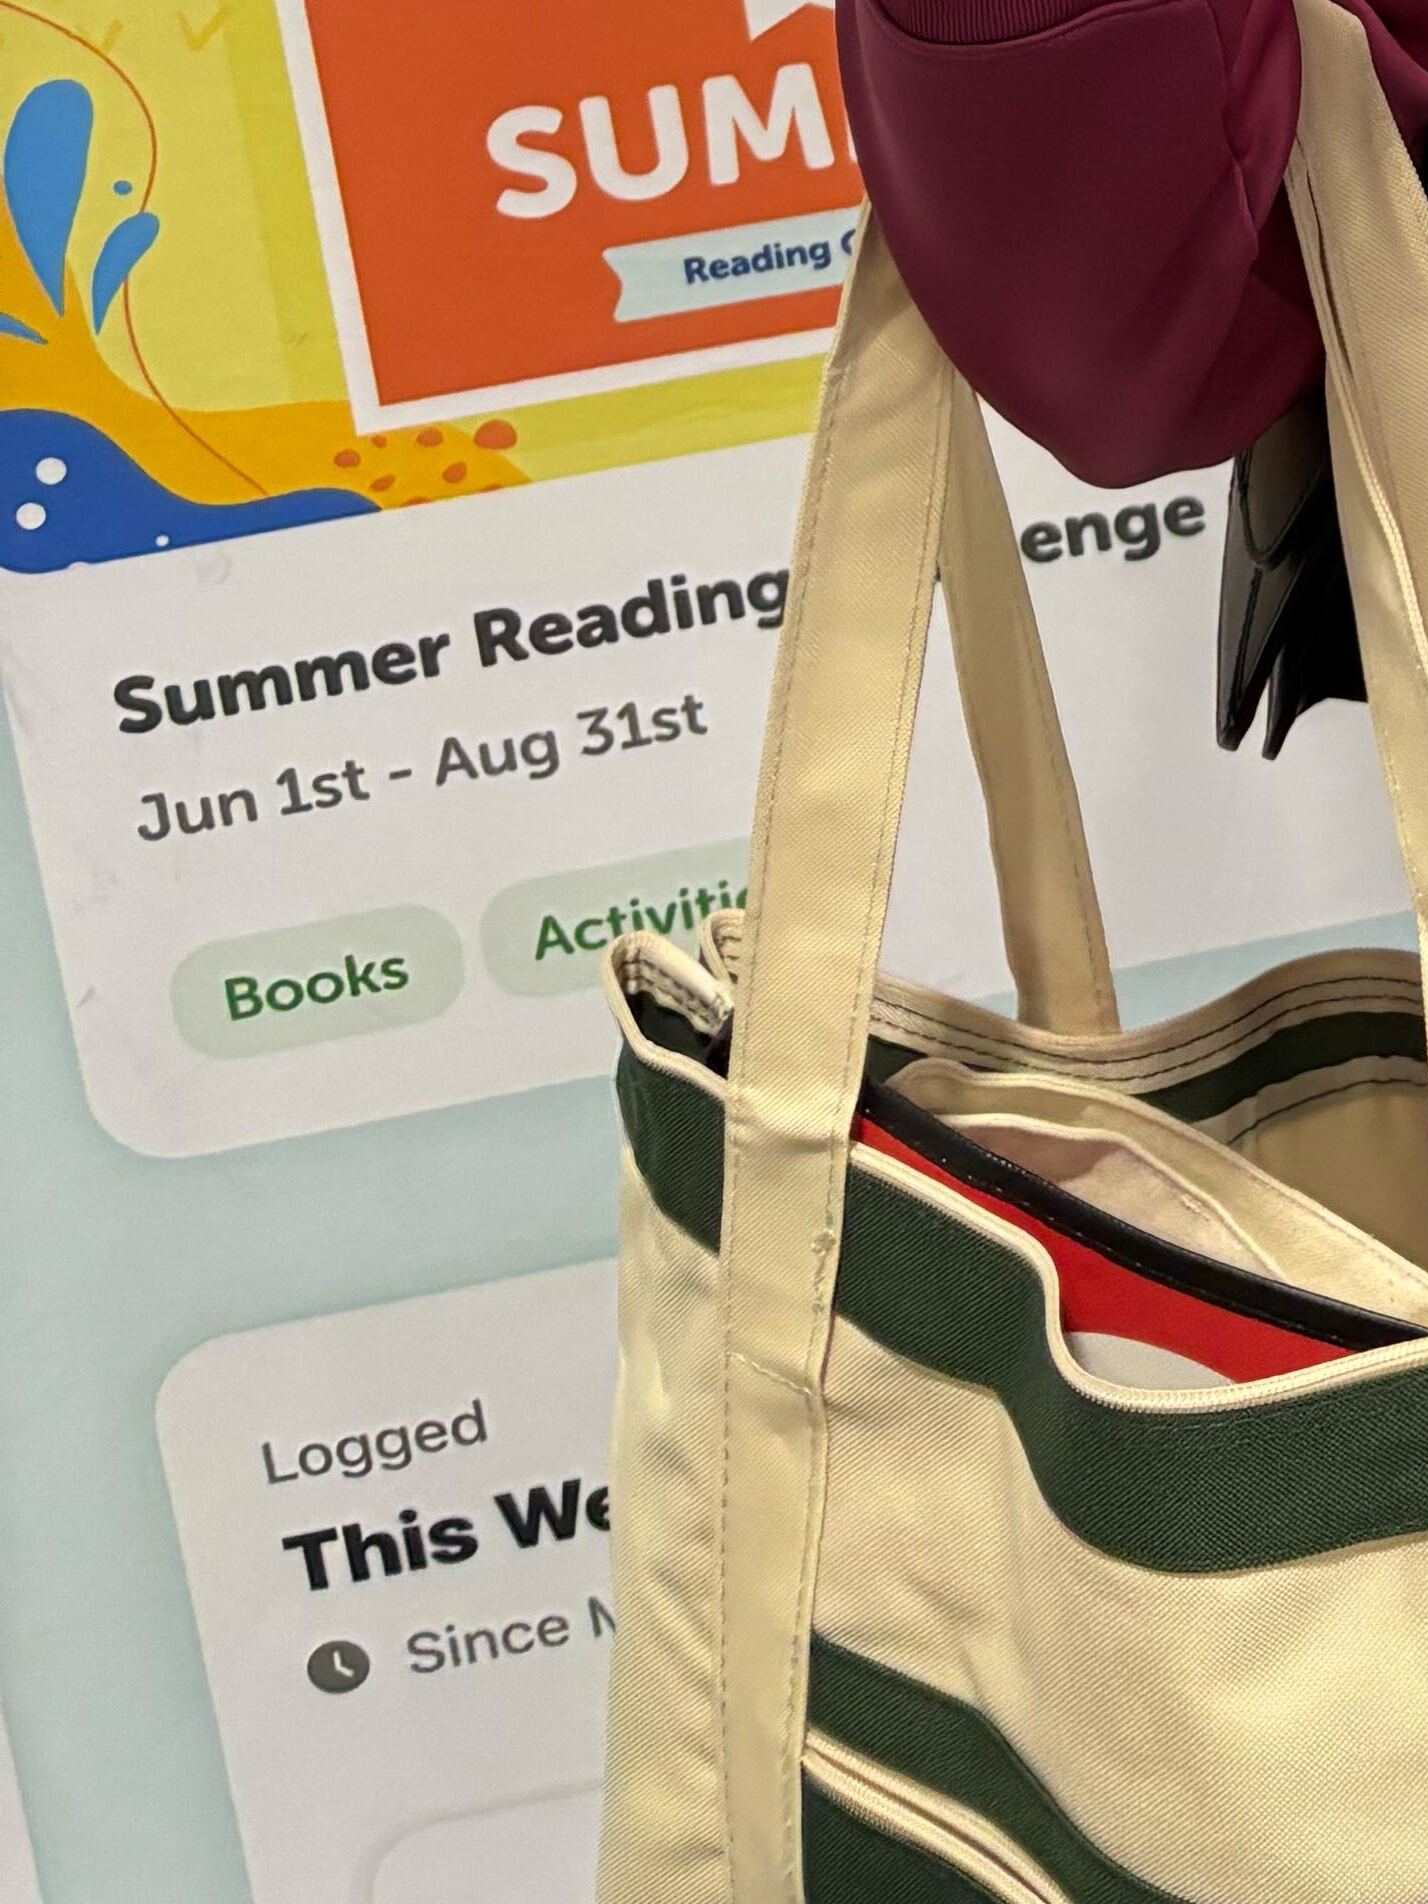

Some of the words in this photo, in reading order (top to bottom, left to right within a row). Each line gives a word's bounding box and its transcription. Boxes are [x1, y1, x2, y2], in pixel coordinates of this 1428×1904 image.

[486, 61, 858, 220] SUM
[683, 239, 832, 286] Reading
[112, 630, 451, 735] Summer
[473, 566, 793, 669] Reading
[1019, 495, 1207, 563] enge
[136, 788, 260, 842] Jun
[275, 758, 371, 817] 1st
[435, 724, 561, 787] Aug
[576, 693, 709, 757] 31st
[223, 952, 410, 1023] Books
[535, 879, 748, 961] Activiti
[260, 1398, 490, 1486] Logged
[281, 1507, 480, 1592] This
[494, 1477, 612, 1549] We
[405, 1613, 571, 1674] Since
